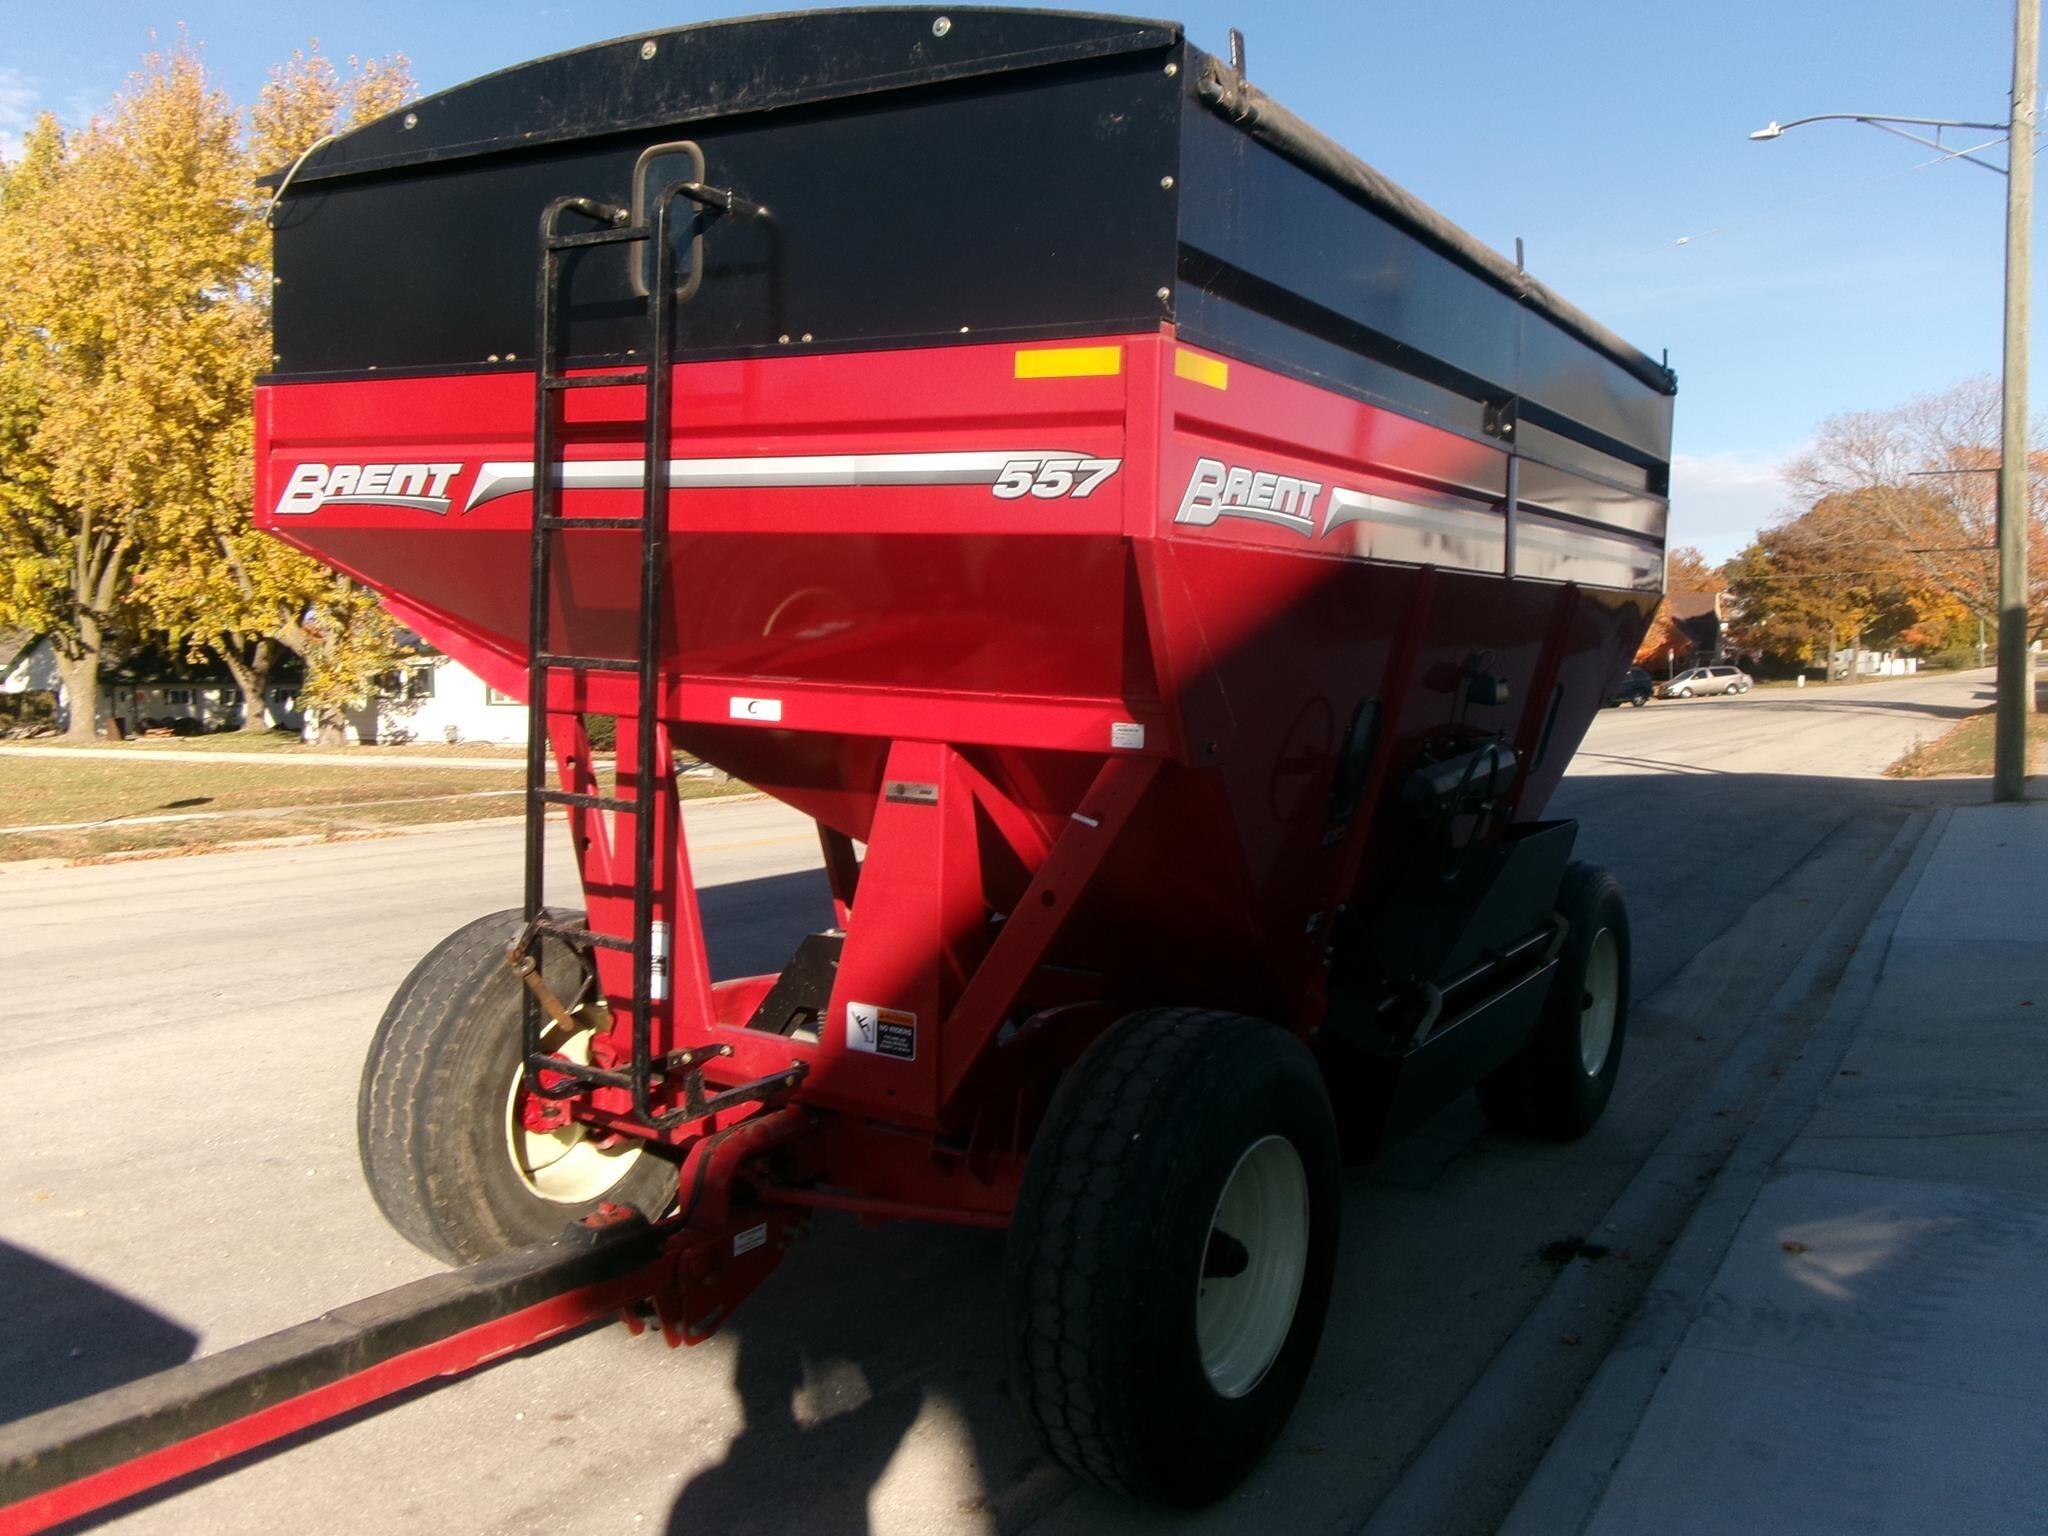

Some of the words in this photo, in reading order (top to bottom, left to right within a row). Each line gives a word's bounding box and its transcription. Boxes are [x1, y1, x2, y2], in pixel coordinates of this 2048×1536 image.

[274, 463, 464, 514] BRENT
[992, 457, 1122, 498] 557
[1173, 456, 1323, 528] BRENT
[747, 700, 760, 714] C
